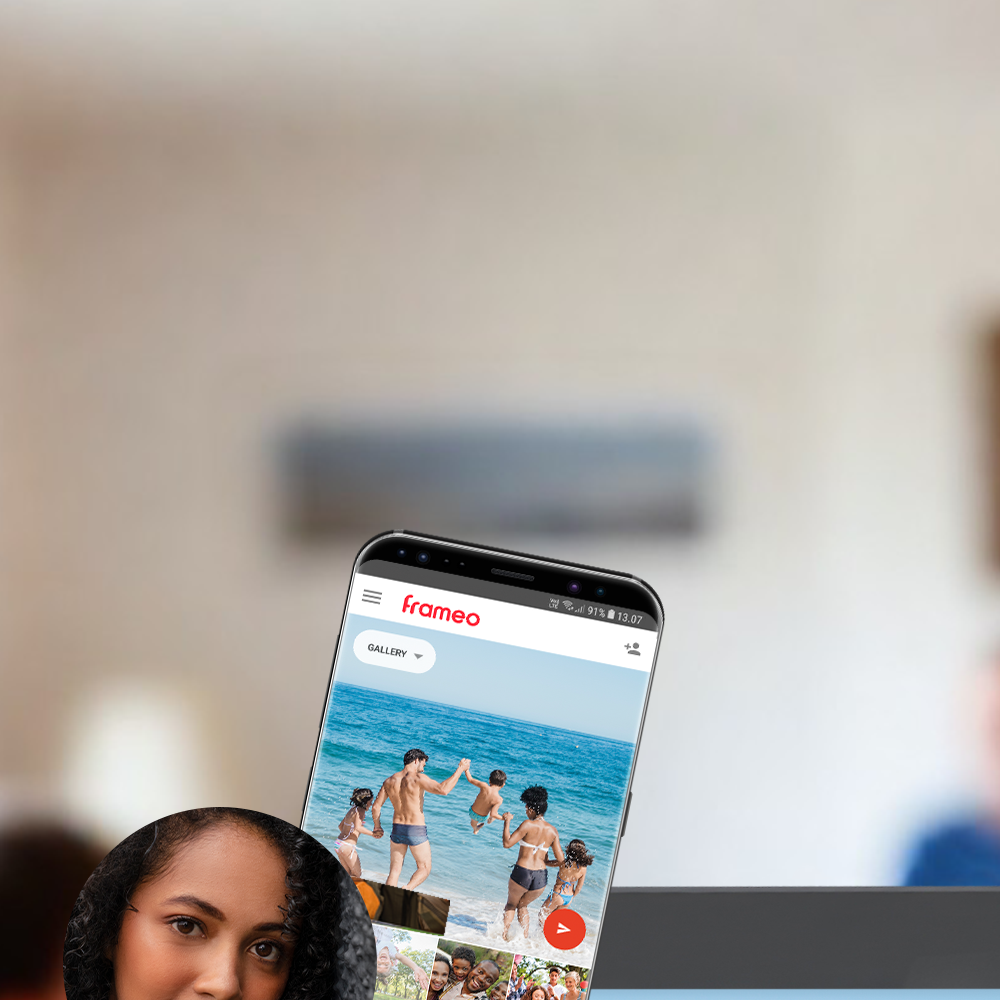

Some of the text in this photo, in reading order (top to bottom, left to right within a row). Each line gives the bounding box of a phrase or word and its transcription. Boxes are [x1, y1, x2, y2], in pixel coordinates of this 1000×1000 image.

[401, 594, 481, 627] frameo
[587, 606, 643, 625] 91% 13.07
[367, 643, 408, 658] GALLERY
